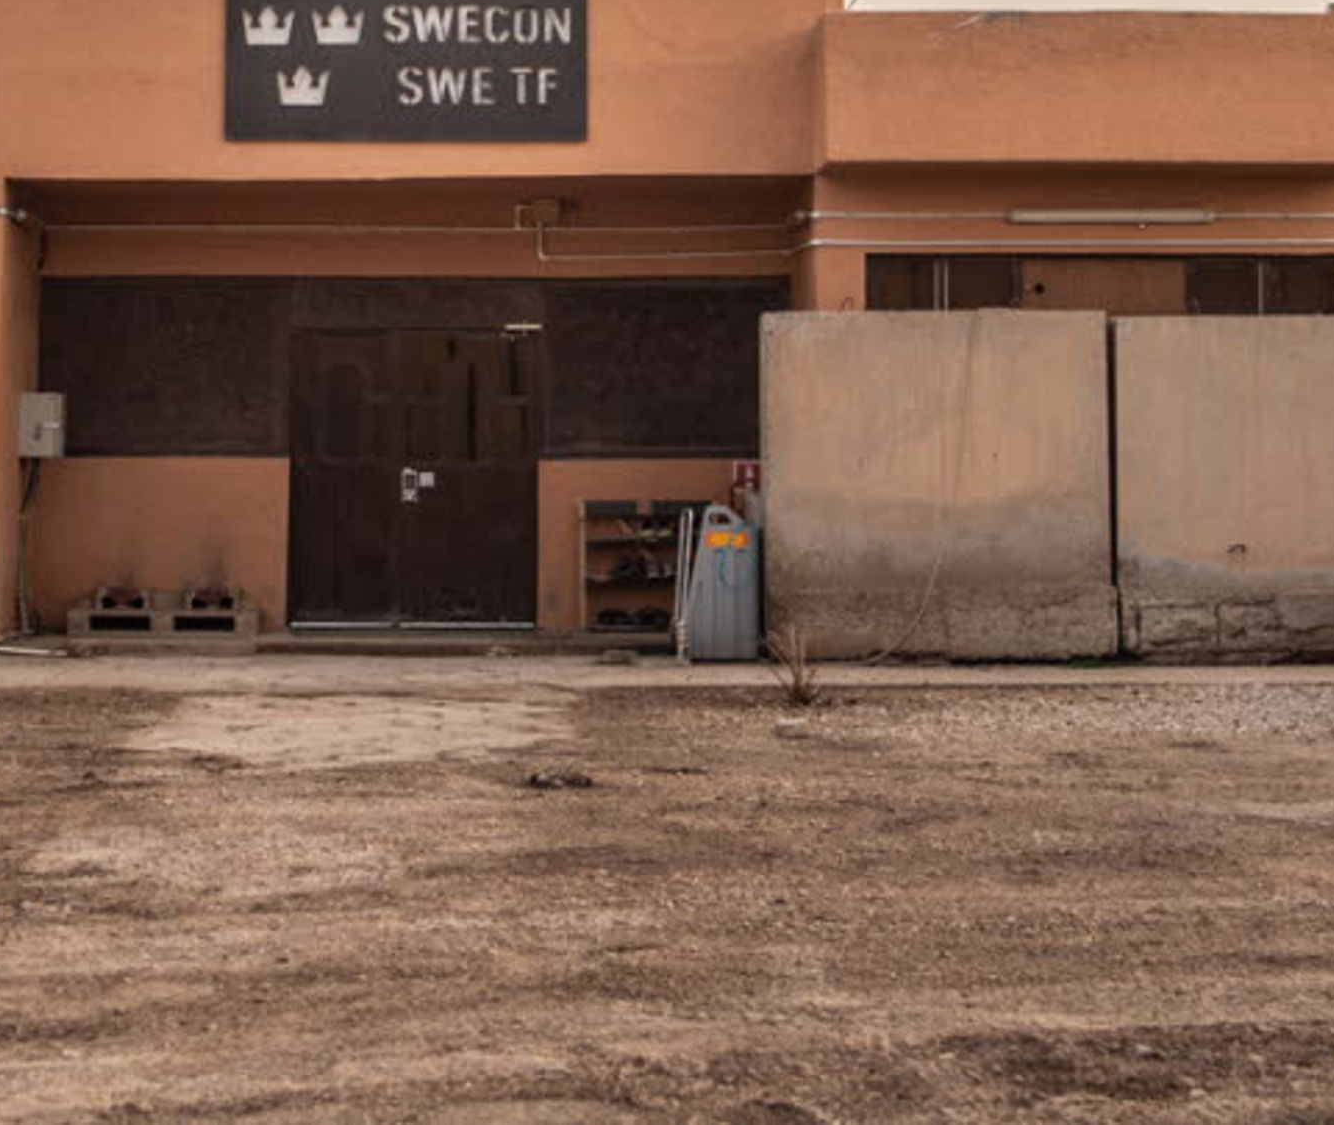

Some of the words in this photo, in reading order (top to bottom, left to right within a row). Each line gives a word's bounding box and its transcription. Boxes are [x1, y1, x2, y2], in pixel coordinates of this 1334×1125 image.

[383, 5, 572, 43] SWECON
[398, 67, 495, 105] SWE
[509, 67, 558, 105] TF
